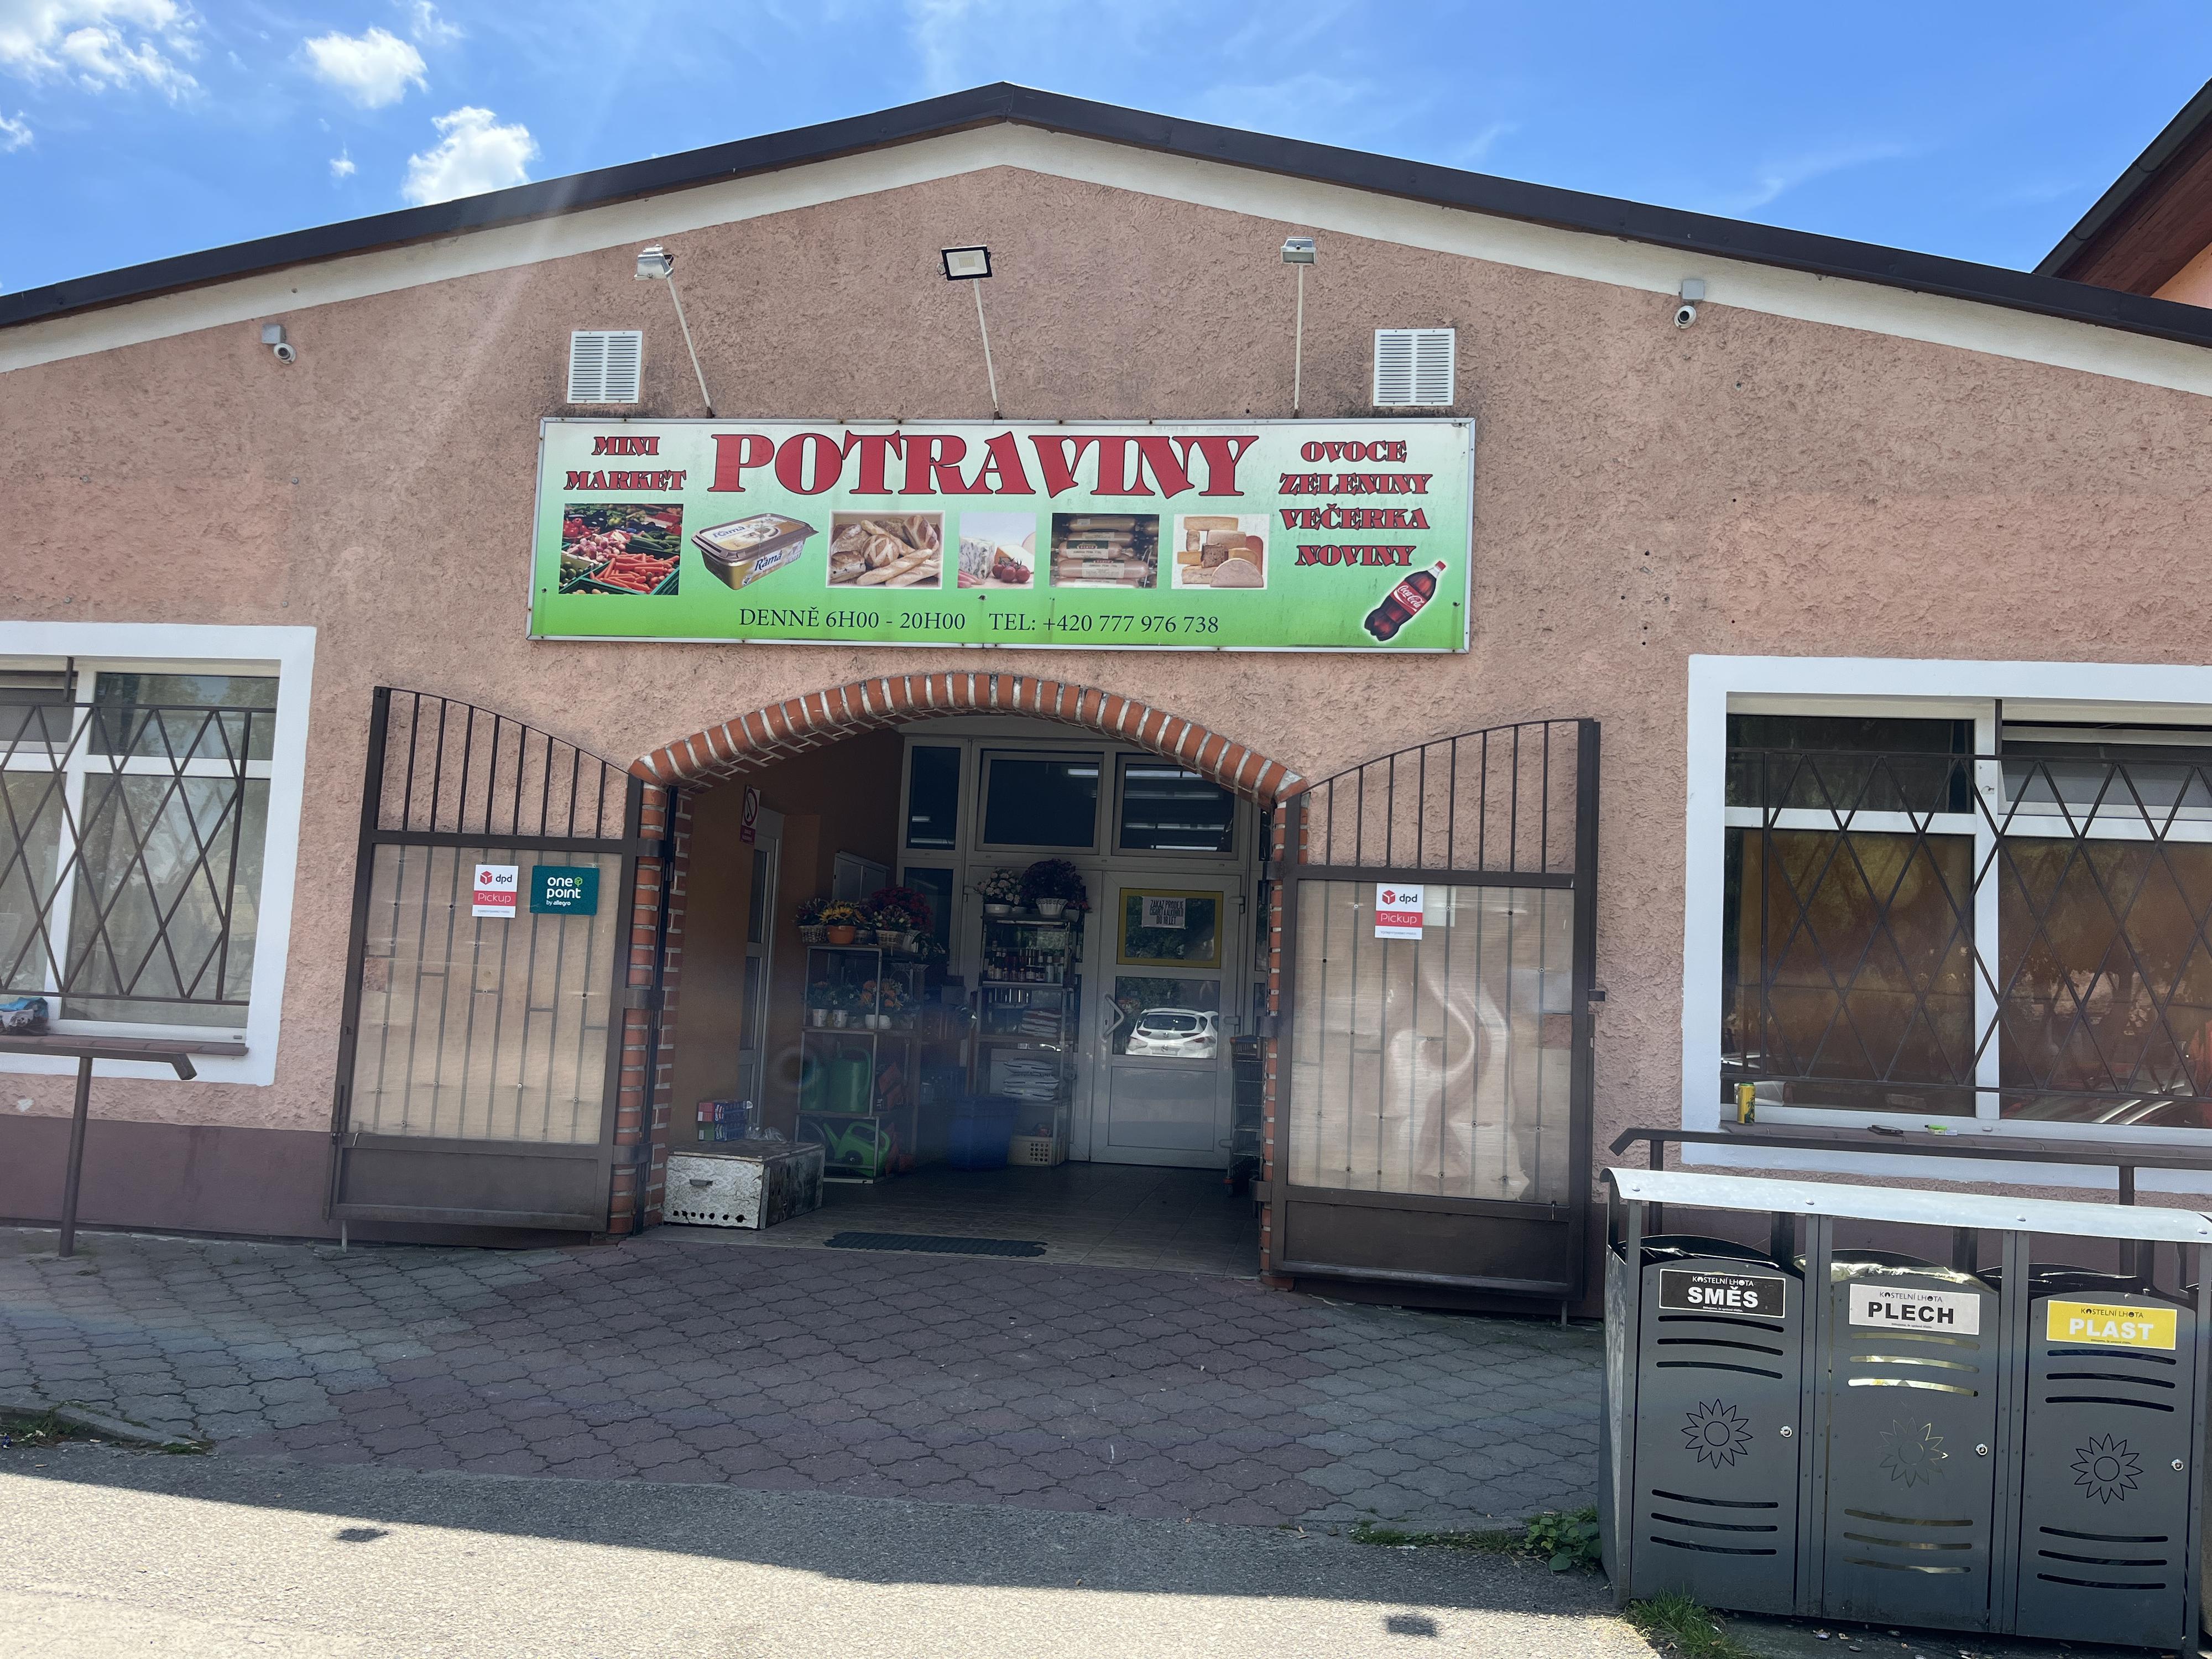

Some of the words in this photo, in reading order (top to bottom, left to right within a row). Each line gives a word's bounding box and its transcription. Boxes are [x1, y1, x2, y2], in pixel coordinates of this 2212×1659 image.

[591, 436, 660, 456] MINI
[1301, 440, 1407, 463] OVOCE
[707, 430, 1259, 499] POTRAVINY
[564, 470, 687, 492] MARKET
[1278, 473, 1433, 495] ZELENINY
[1279, 503, 1430, 530] VEČERKA
[1295, 545, 1417, 567] NOVINY
[739, 607, 819, 627] DENNĚ
[826, 611, 879, 628] 6H00
[899, 612, 966, 630] 20H00
[989, 613, 1036, 631] TEL:
[1043, 615, 1093, 632] +420
[1099, 615, 1134, 632] 777
[1141, 616, 1177, 633] 976
[1183, 616, 1219, 633] 738
[495, 874, 513, 884] dpd
[547, 877, 573, 887] one
[478, 893, 512, 903] Pickup
[546, 888, 581, 899] point
[1399, 894, 1418, 904] dpd
[1165, 901, 1183, 909] PRODEJE
[1156, 916, 1162, 925] DO
[1164, 916, 1168, 925] 18
[1380, 914, 1417, 925] Pickup
[1692, 1276, 1728, 1285] KOSTELNÍ
[1687, 1286, 1759, 1308] SMĚS
[1880, 1291, 1916, 1300] KOSTELNÍ
[1868, 1302, 1954, 1324] PLECH
[2080, 1308, 2117, 1317] KOSTELNÍ
[2069, 1318, 2154, 1340] PLAST
